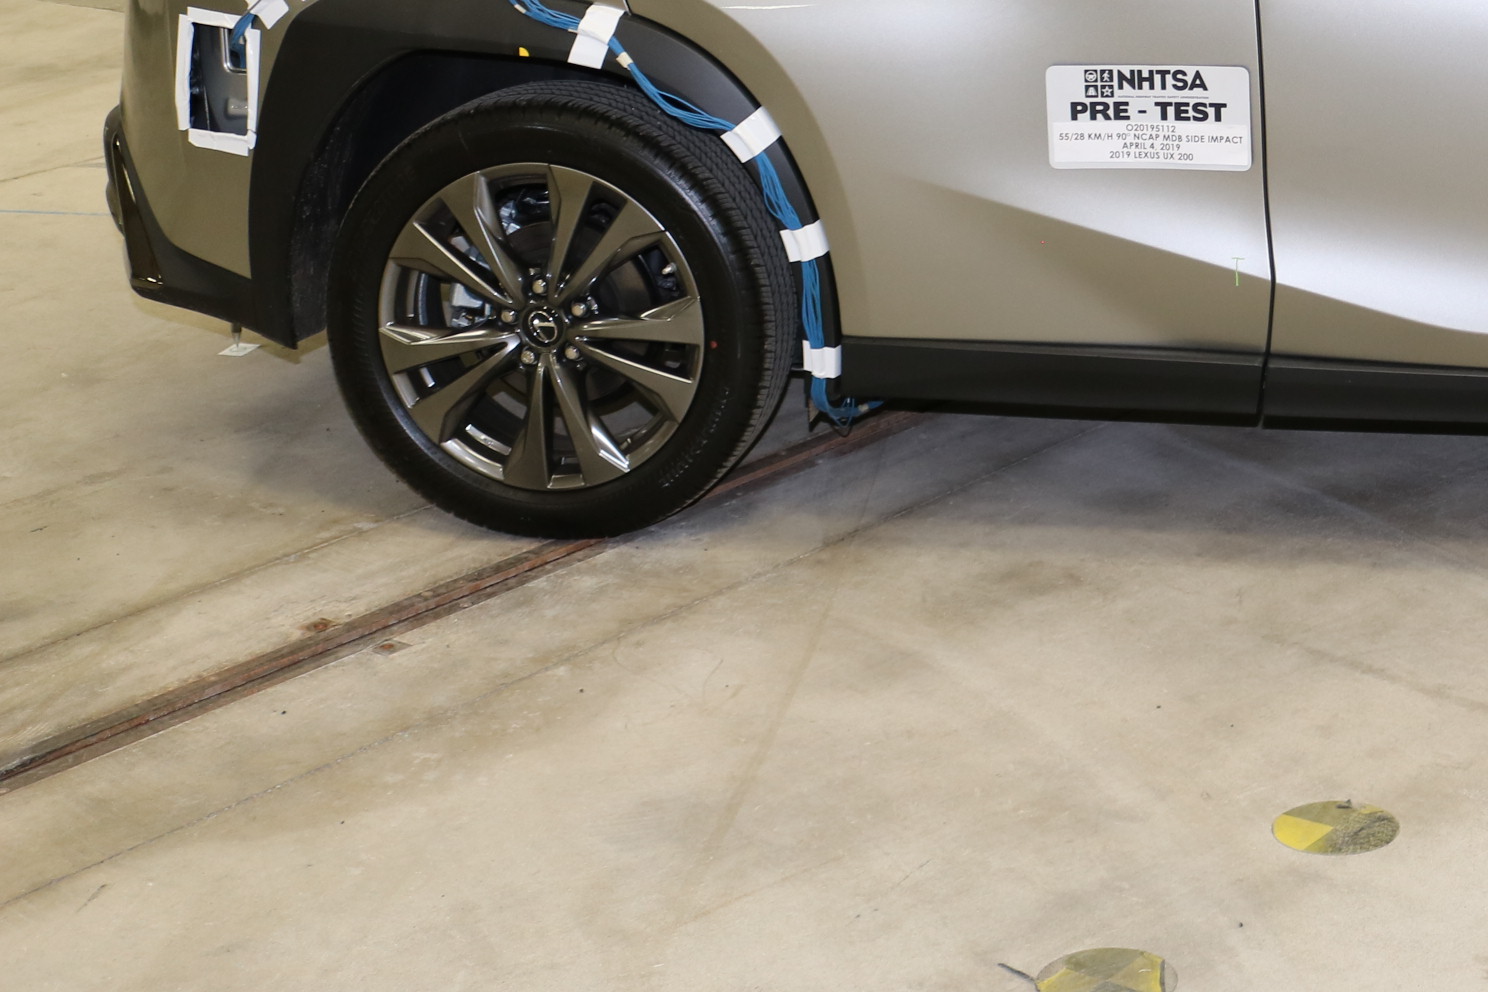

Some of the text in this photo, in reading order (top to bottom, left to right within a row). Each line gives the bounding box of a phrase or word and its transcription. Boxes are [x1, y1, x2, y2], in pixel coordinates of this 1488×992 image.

[1117, 69, 1208, 91] NHTSA
[1070, 101, 1131, 121] PRE
[1154, 101, 1227, 122] TEST
[1058, 132, 1085, 141] 55/28
[1087, 132, 1113, 141] KM/H
[1133, 133, 1160, 141] NCAP
[1162, 134, 1183, 143] MDB
[1185, 134, 1205, 143] SIDE
[1207, 135, 1243, 144] IMPACT
[1121, 142, 1147, 150] APRIL
[1159, 143, 1181, 151] 2019
[1109, 150, 1194, 161] 2019 LEXUS UX 200
